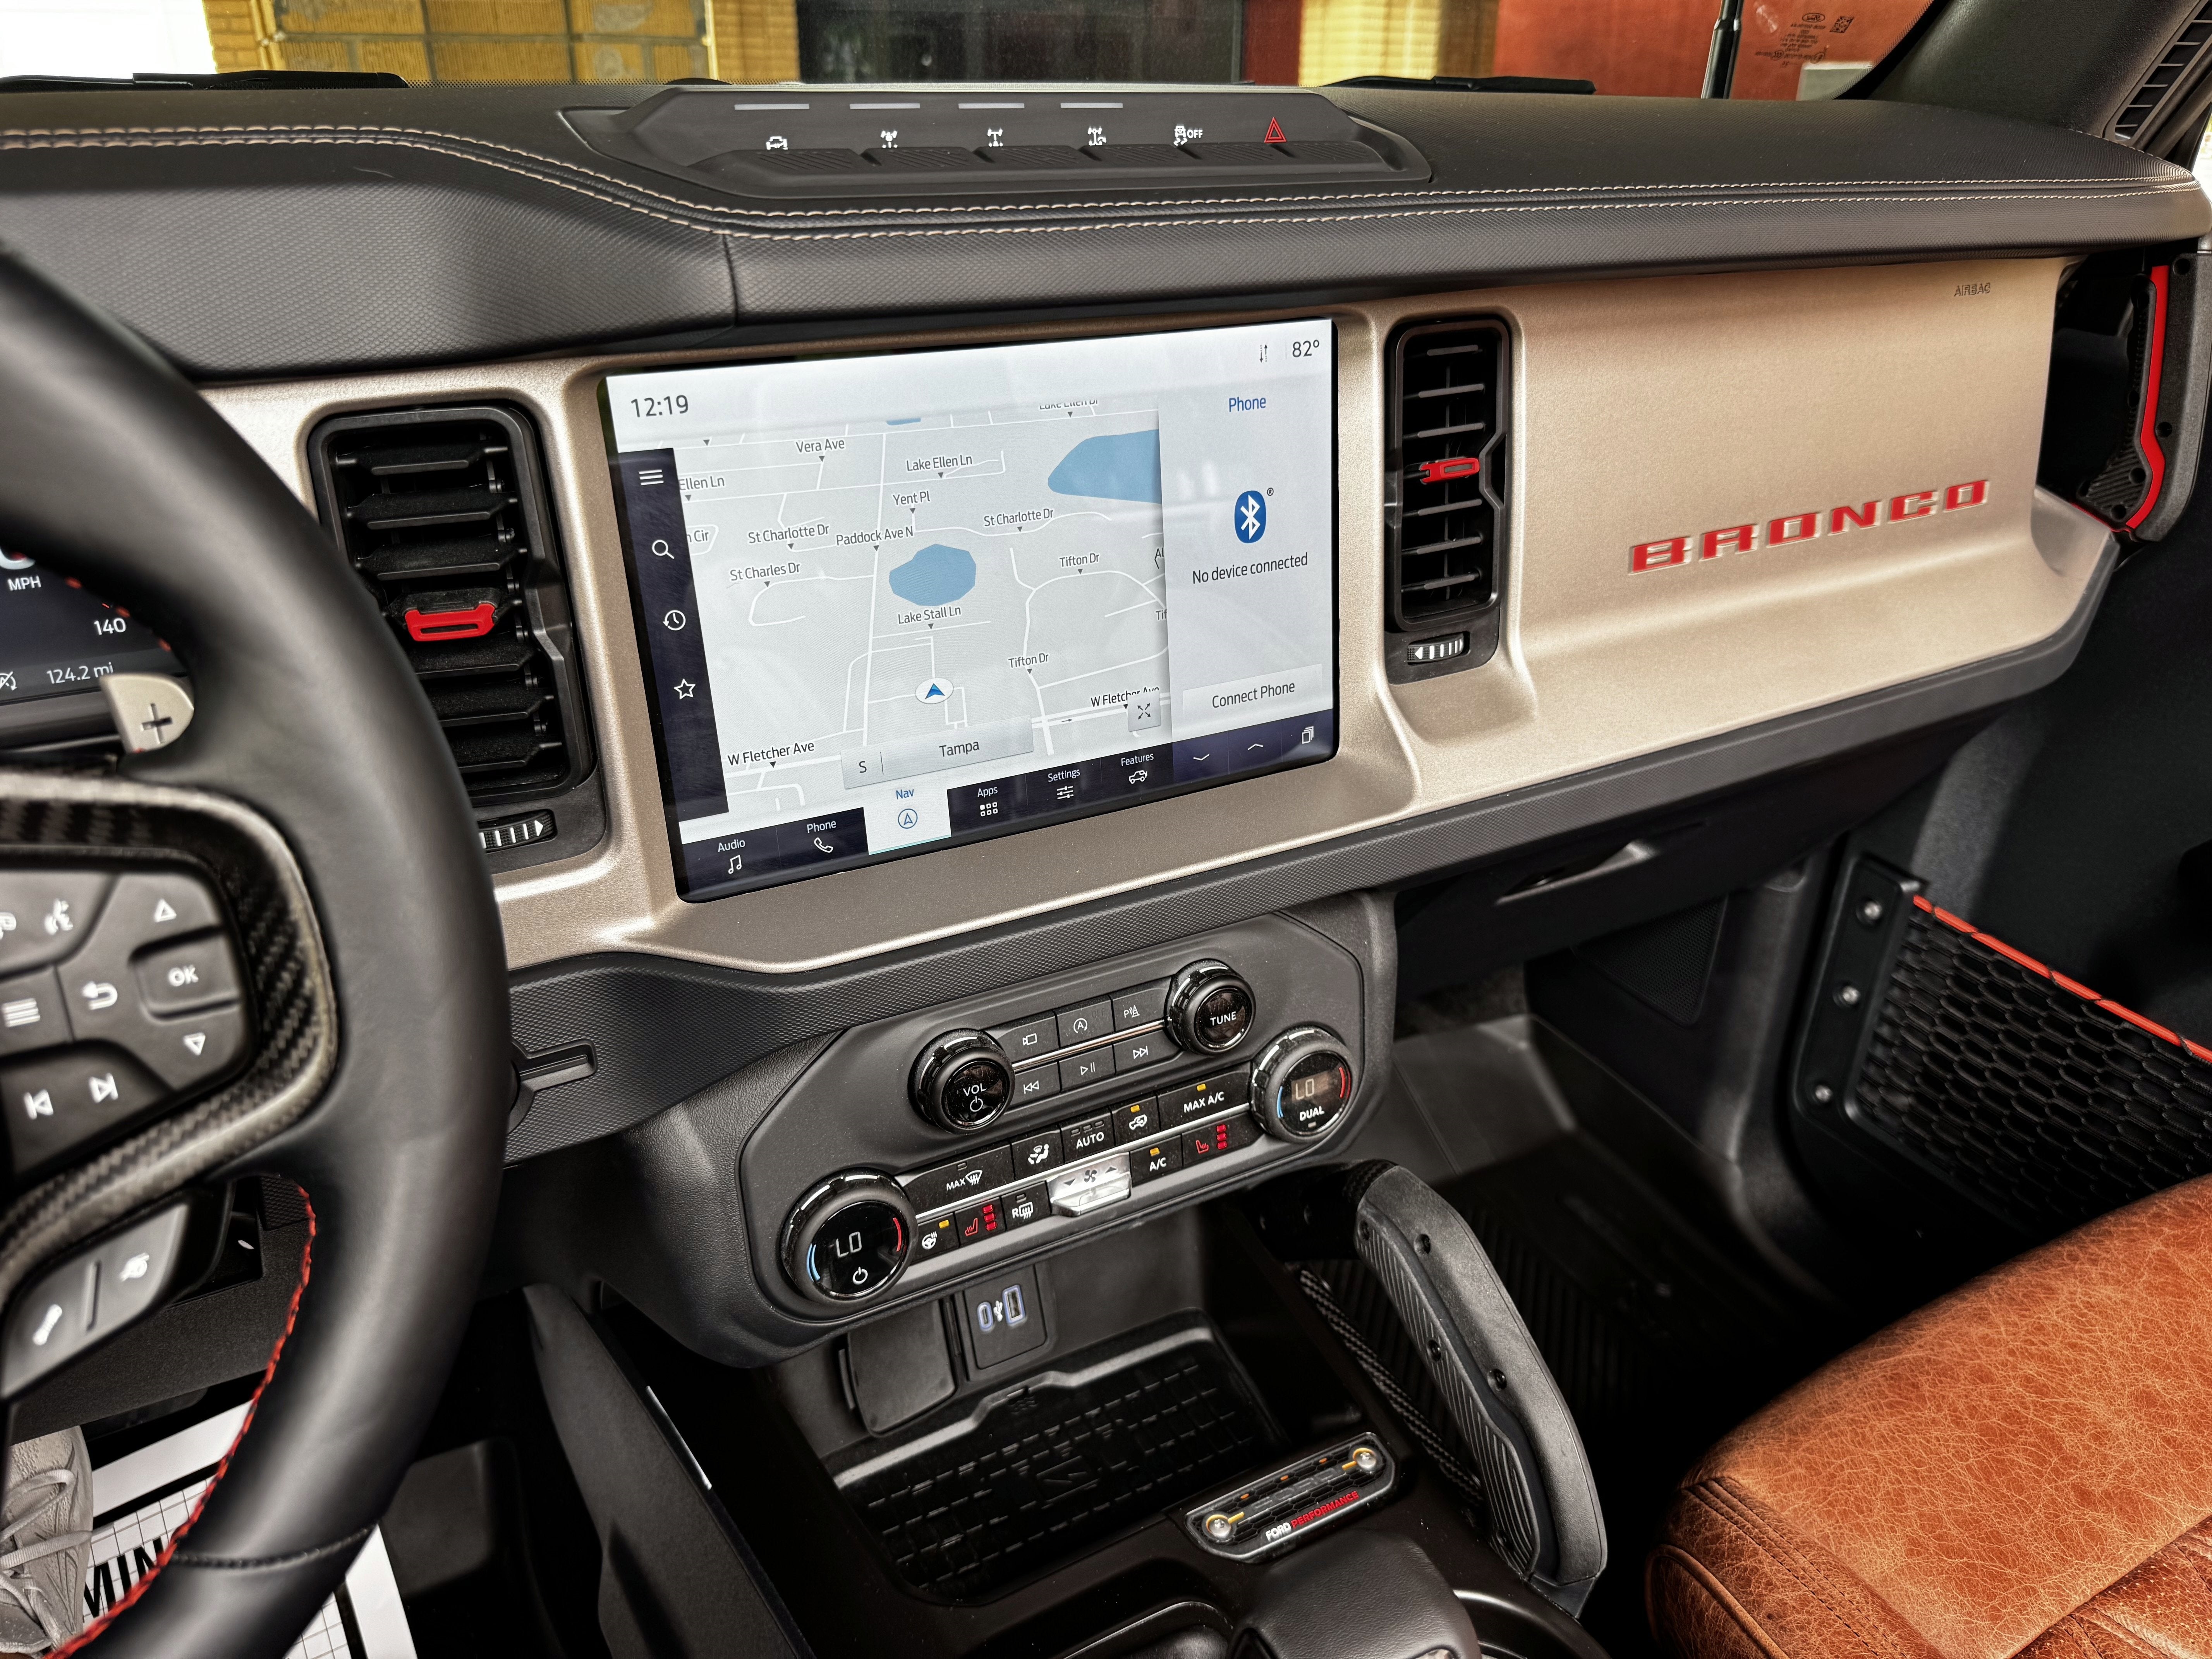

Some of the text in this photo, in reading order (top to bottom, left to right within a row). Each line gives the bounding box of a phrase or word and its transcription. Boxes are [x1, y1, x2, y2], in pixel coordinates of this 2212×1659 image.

[1187, 129, 1203, 139] OFF
[1954, 282, 1990, 297] AIRBAG
[631, 395, 688, 417] 12:19
[1229, 397, 1266, 412] Phone
[796, 439, 845, 453] Vera Ave
[907, 455, 972, 471] Lake Ellen Ln
[710, 476, 725, 487] Ln
[893, 491, 930, 505] Yent Pl
[984, 508, 1054, 527] St Charlotte Dr
[748, 524, 829, 543] St Charlotte Dr
[1629, 480, 1989, 575] BRONCO
[694, 530, 709, 542] Cir
[836, 526, 913, 546] Paddock Ave N
[1059, 553, 1099, 567] Tifton Dr
[730, 562, 800, 581] St Charles Dr
[1193, 552, 1307, 584] No device connected
[7, 576, 41, 591] MPH
[898, 606, 961, 624] Lake Stall Ln
[94, 618, 126, 635] 140
[1008, 653, 1049, 668] Tifton Dr
[46, 661, 113, 684] 124.2 mi
[1091, 696, 1100, 707] W
[1212, 683, 1295, 708] Connect Phone
[727, 742, 814, 766] W Fletcher Ave
[939, 742, 980, 757] Tampa
[859, 761, 867, 773] S
[1121, 753, 1154, 766] Features
[1048, 769, 1080, 782] Settings
[896, 789, 914, 800] Nav
[977, 787, 998, 798] Apps
[807, 821, 836, 833] Phone
[718, 839, 745, 852] Audio
[168, 966, 199, 986] OK
[1210, 1011, 1237, 1026] TUNE
[963, 1083, 986, 1096] VOL
[1183, 1091, 1224, 1113] MAX A/C
[1299, 1106, 1324, 1121] DUAL
[1075, 1132, 1104, 1149] AUTO
[1149, 1157, 1167, 1171] A/C
[946, 1178, 966, 1191] MAX
[1266, 1491, 1360, 1542] FORD PERFORMANCE
